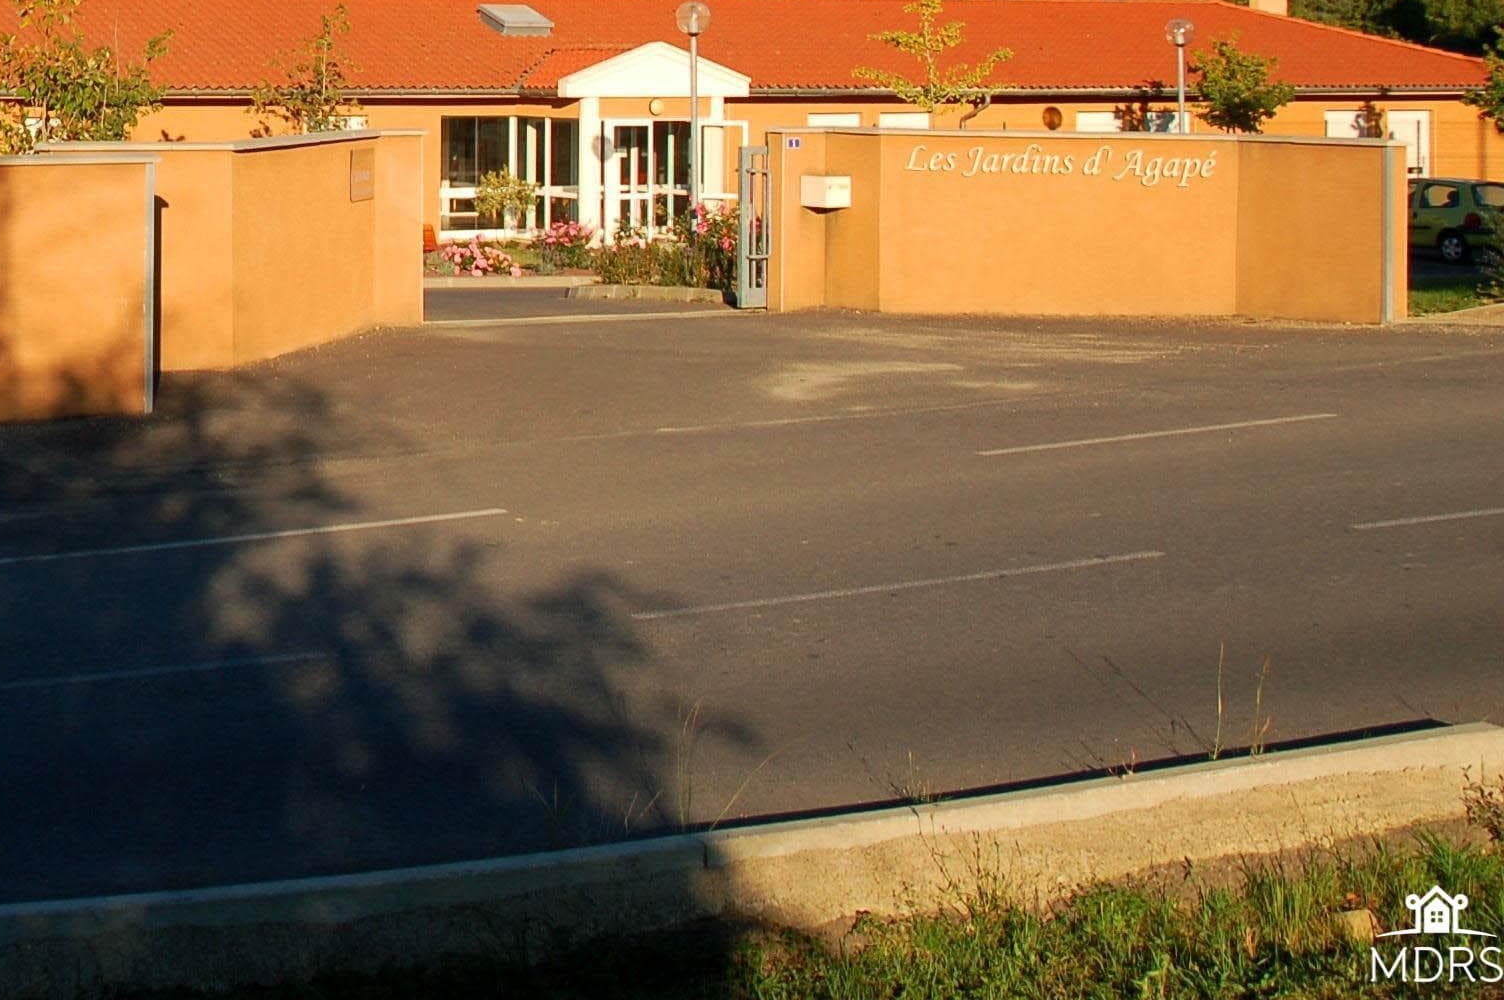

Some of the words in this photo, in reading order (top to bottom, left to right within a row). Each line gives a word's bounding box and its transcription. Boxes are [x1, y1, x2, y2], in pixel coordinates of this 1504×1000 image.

[907, 144, 957, 172] Les
[961, 143, 1075, 178] Jardins
[1113, 148, 1218, 188] Agapé
